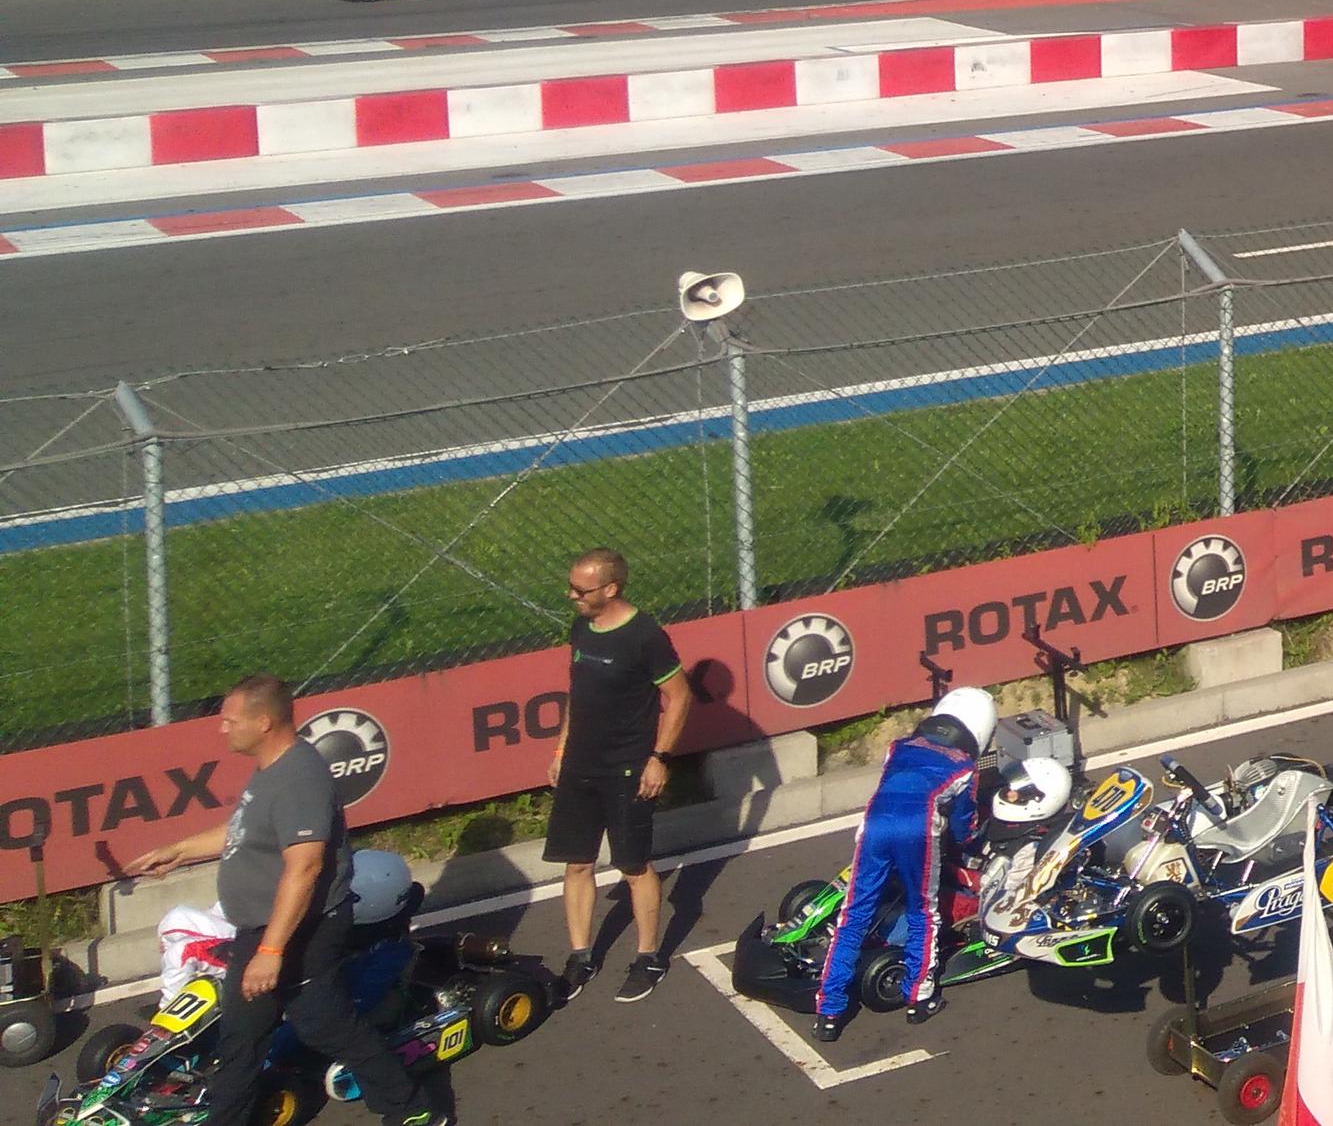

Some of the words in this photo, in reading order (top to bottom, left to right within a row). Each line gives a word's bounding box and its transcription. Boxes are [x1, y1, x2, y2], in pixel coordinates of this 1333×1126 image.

[1201, 573, 1243, 595] BRP
[924, 575, 1130, 656] ROTAX
[801, 655, 850, 679] BRP
[170, 992, 207, 1020] 101
[444, 1033, 463, 1052] 101
